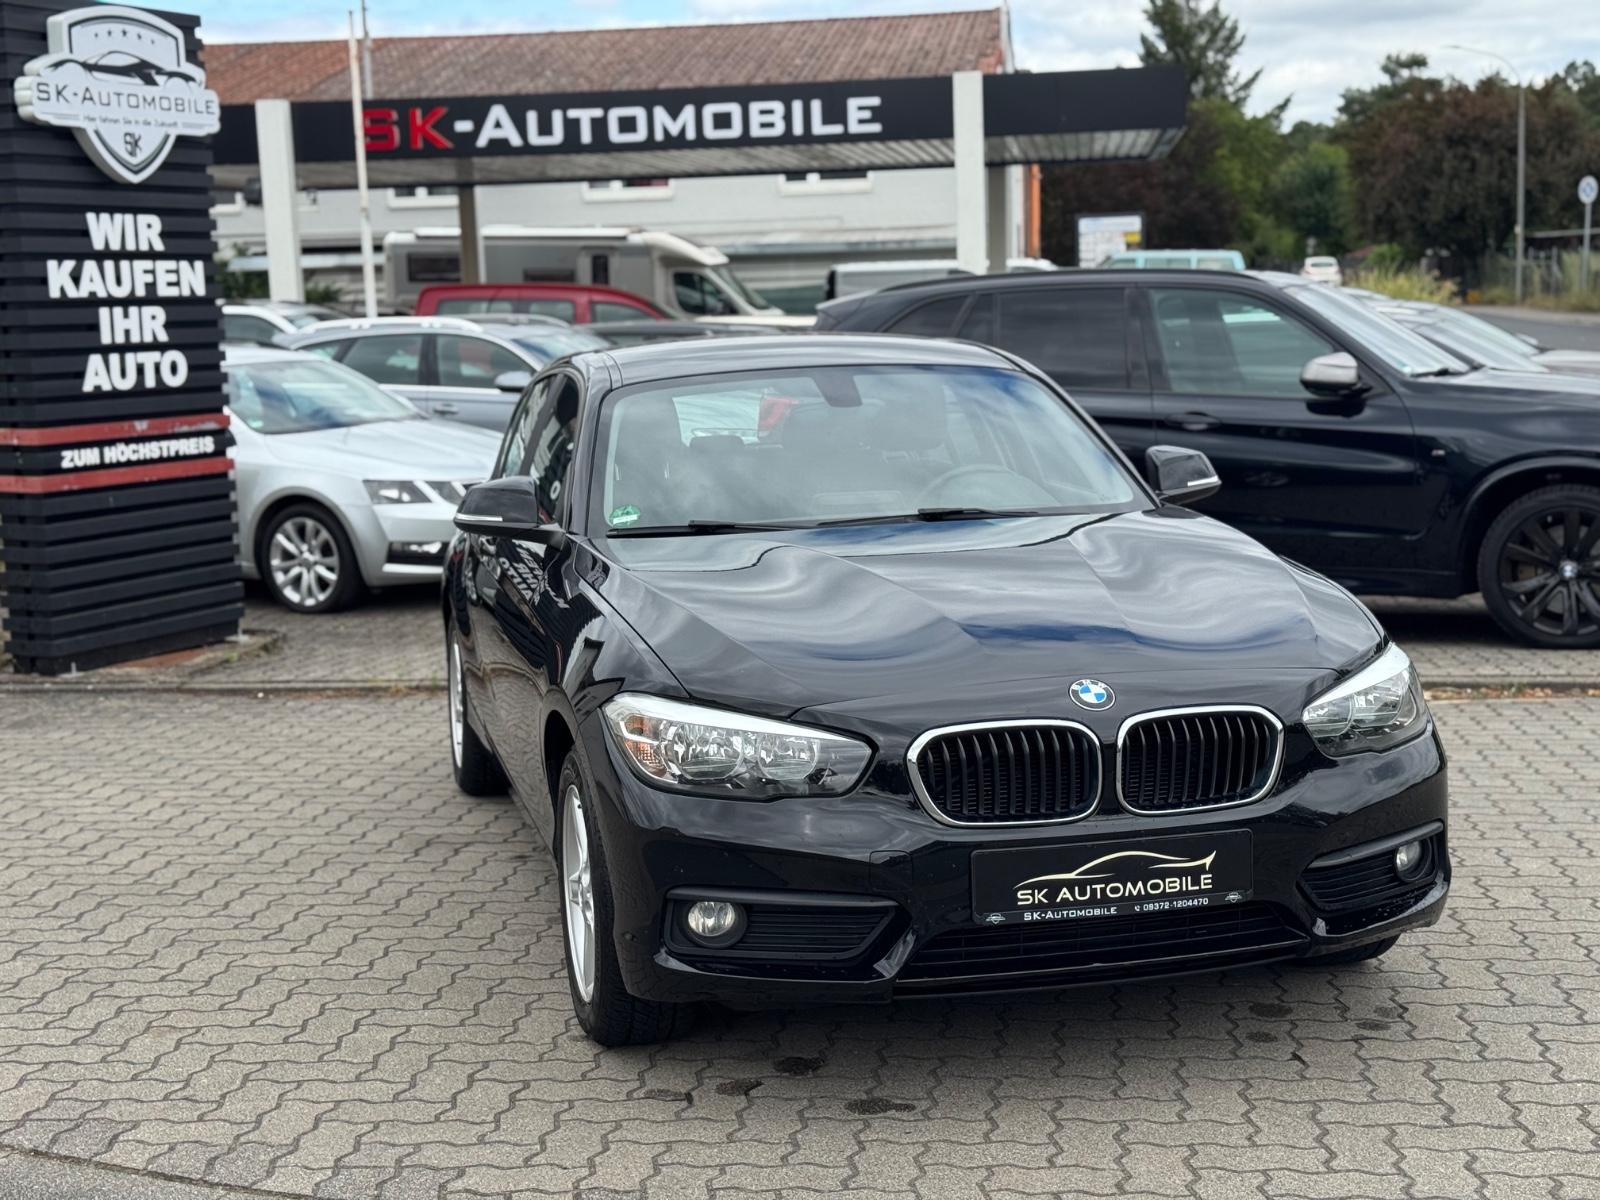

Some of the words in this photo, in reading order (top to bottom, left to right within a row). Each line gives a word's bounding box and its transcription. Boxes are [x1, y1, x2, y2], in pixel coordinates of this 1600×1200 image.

[85, 212, 166, 252] WIR
[46, 259, 207, 299] KAUFEN
[98, 305, 170, 345] IHR
[82, 350, 189, 392] AUTO
[61, 447, 101, 469] ZUM
[103, 435, 216, 464] HÖCHSTPREIS
[1016, 887, 1049, 906] SK
[1055, 873, 1213, 903] AUTOMOBILE
